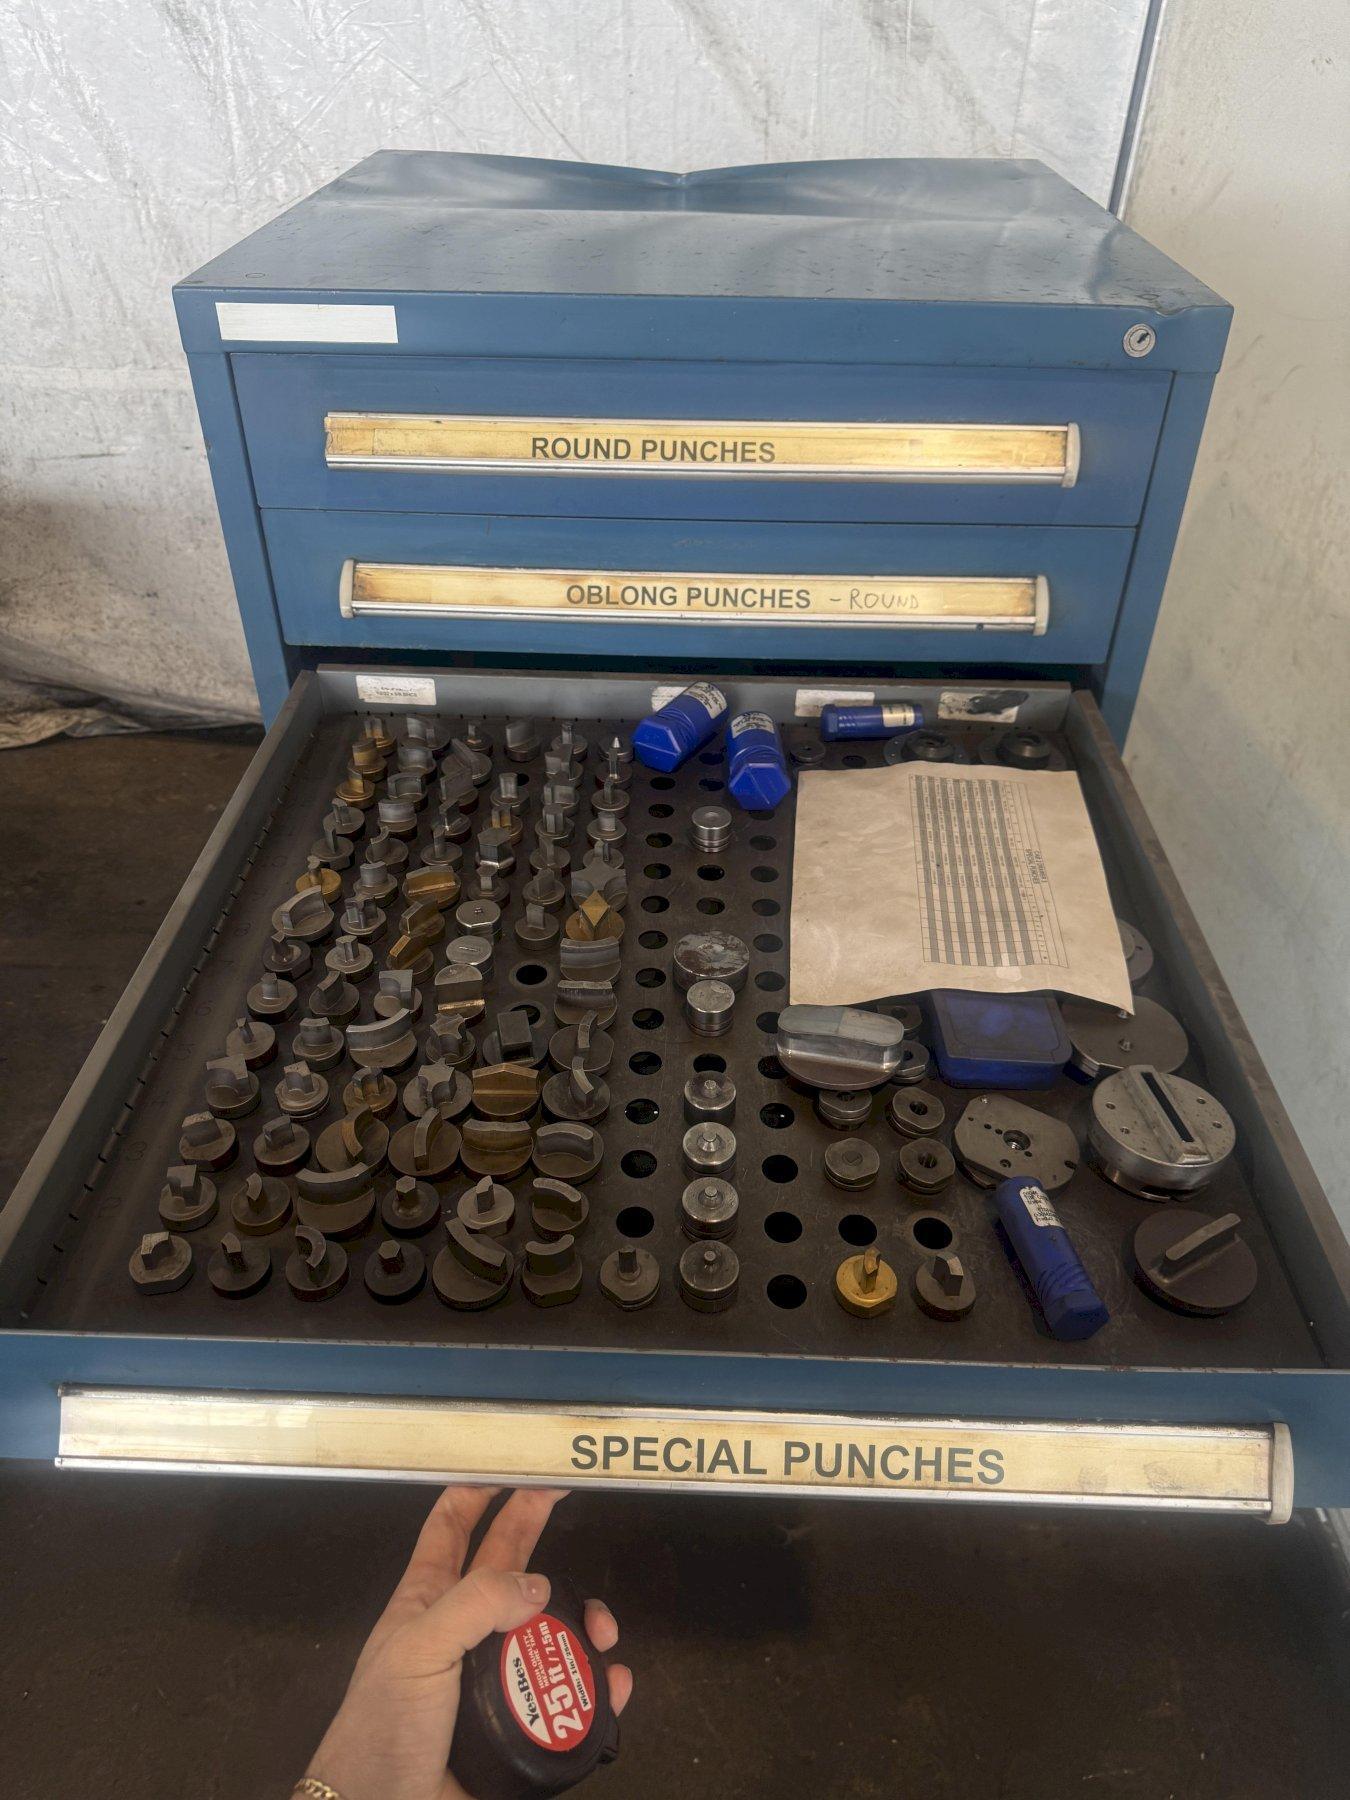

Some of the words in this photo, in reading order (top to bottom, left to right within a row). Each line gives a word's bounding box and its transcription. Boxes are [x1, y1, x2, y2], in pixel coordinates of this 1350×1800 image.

[531, 437, 631, 460] ROUND
[641, 439, 776, 463] PUNCHES
[566, 585, 677, 605] OBLONG
[687, 587, 811, 609] PUNCHES
[849, 588, 920, 610] ROUND
[234, 922, 251, 938] 8
[194, 1000, 213, 1016] 6
[125, 1141, 148, 1161] 3
[97, 1196, 122, 1218] 2
[570, 1434, 767, 1475] SPECIAL
[783, 1441, 1005, 1485] PUNCHES
[526, 1627, 536, 1646] TAPE
[538, 1621, 555, 1653] 7.5m
[522, 1634, 538, 1667] QUALITY
[533, 1648, 549, 1686] MEASURE
[533, 1668, 545, 1688] HIGH
[546, 1663, 565, 1683] ft
[513, 1657, 540, 1726] YesBes
[575, 1677, 588, 1707] Width:
[542, 1683, 583, 1740] 25
